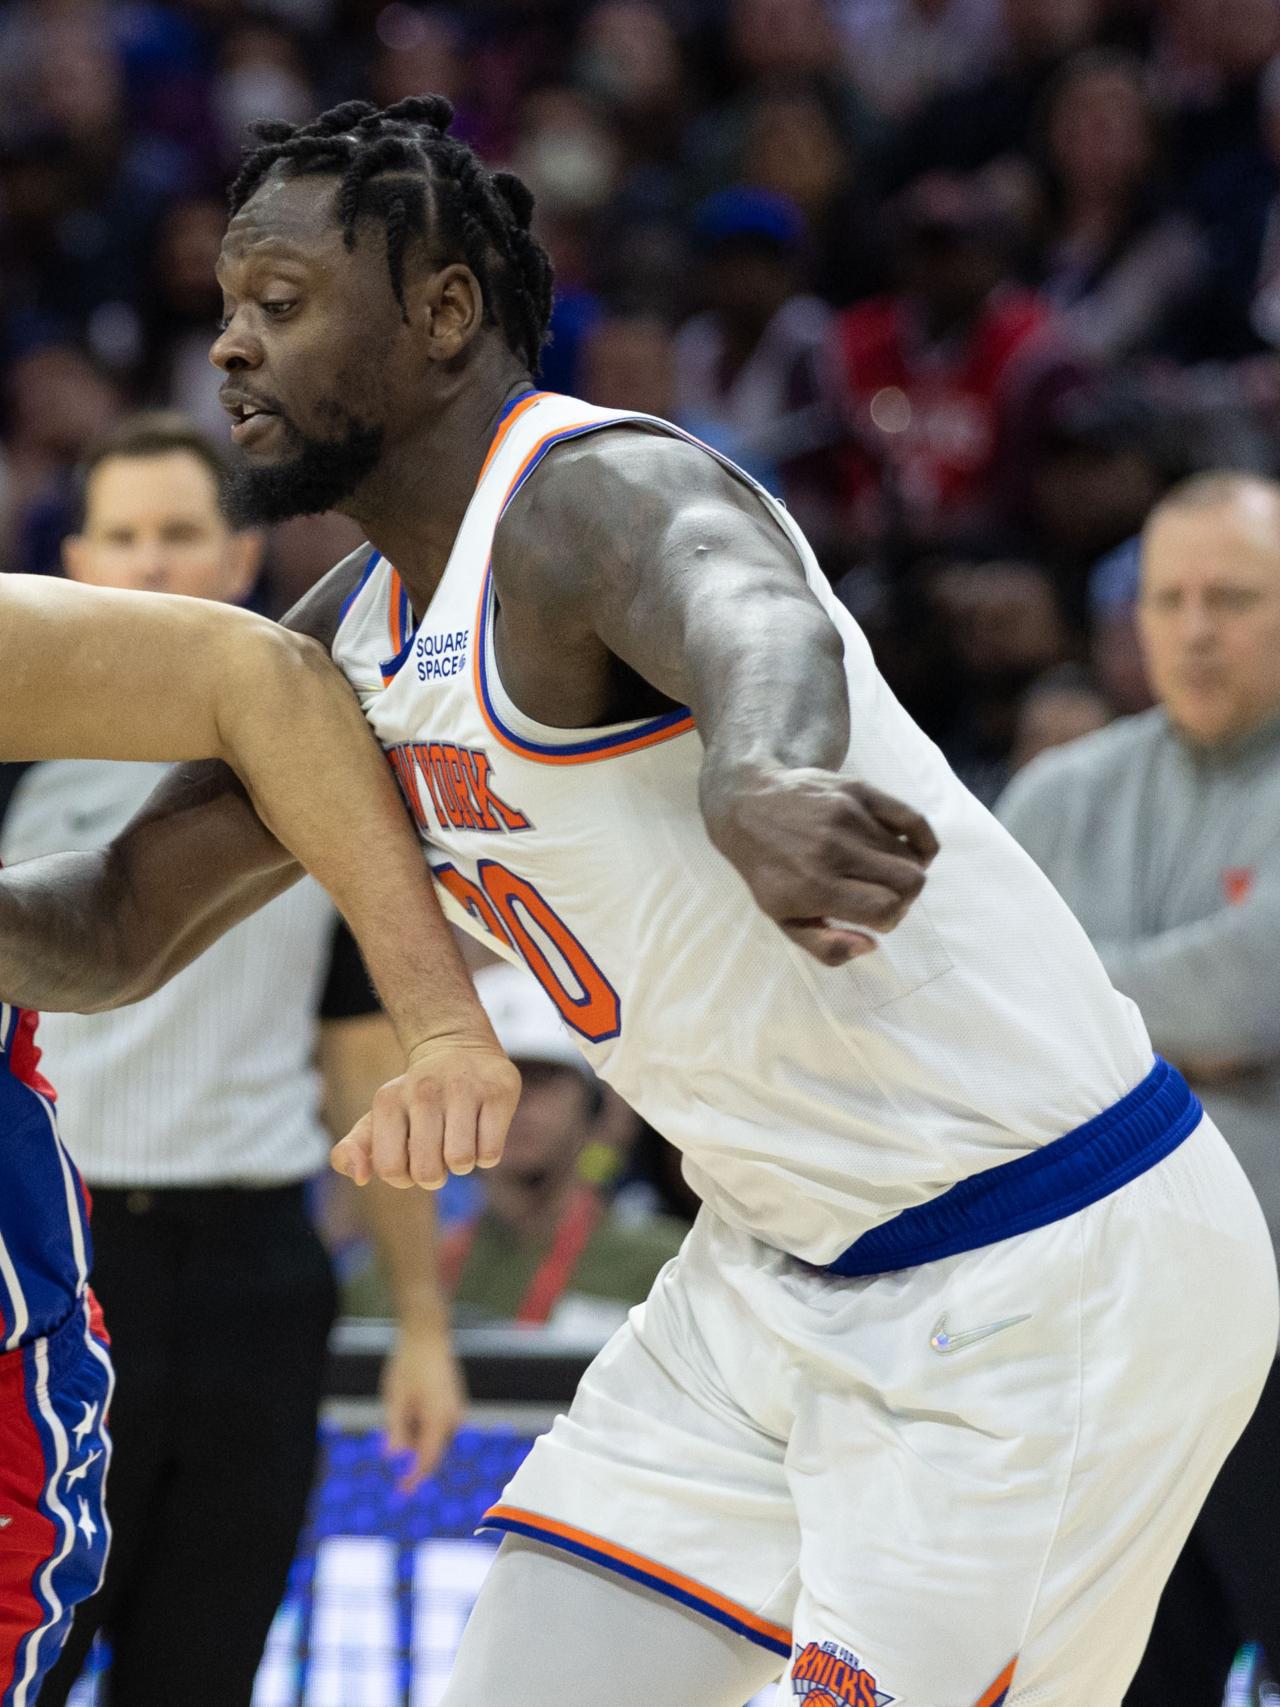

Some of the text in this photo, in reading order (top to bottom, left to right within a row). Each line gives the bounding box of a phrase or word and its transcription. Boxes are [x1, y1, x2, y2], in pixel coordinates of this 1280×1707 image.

[416, 630, 469, 658] SQUARE
[417, 655, 459, 681] SPACE
[412, 741, 536, 834] YORK
[791, 1642, 876, 1707] KNICKS
